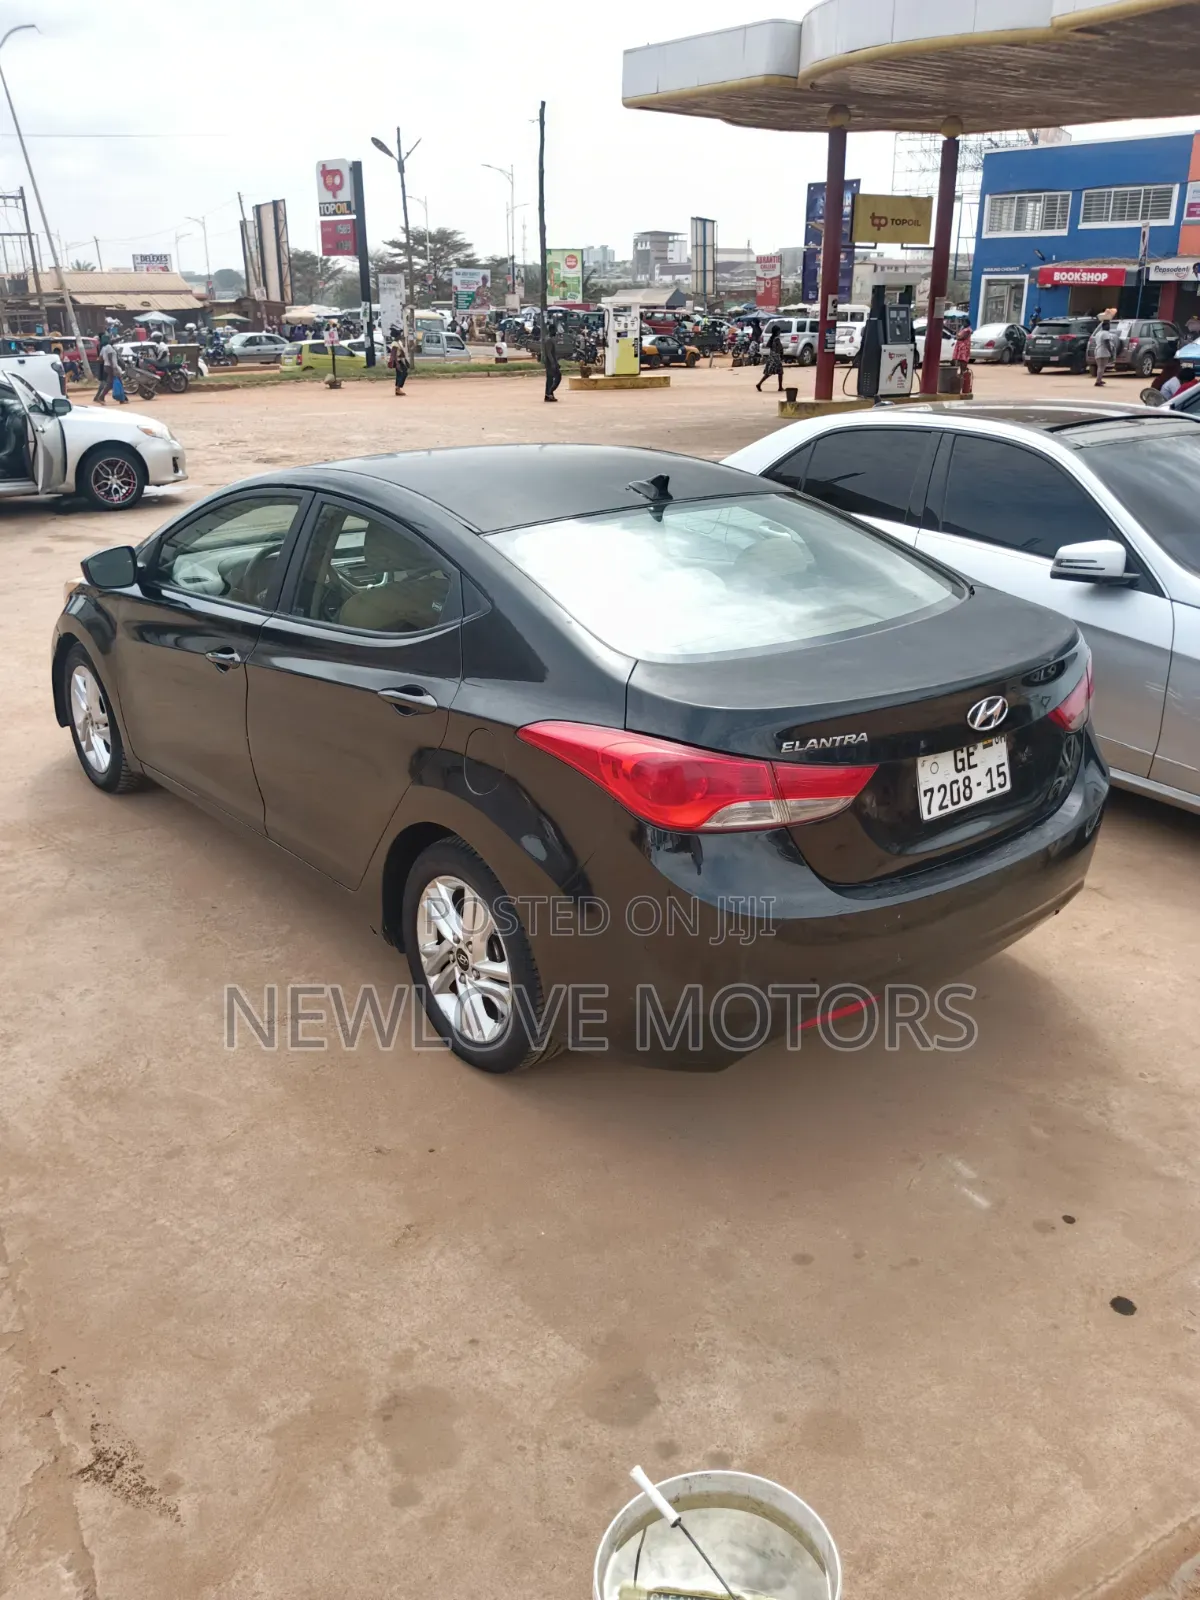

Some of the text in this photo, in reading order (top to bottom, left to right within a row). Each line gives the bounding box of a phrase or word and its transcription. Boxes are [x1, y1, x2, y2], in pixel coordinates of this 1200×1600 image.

[320, 203, 350, 215] TOPOIL
[891, 218, 921, 227] TOPOIL
[1154, 265, 1189, 273] Pepsodent
[1053, 272, 1108, 282] BOOKSHOP
[780, 732, 868, 753] ELANTRA
[953, 745, 978, 774] GE
[923, 762, 1007, 815] 7208-15
